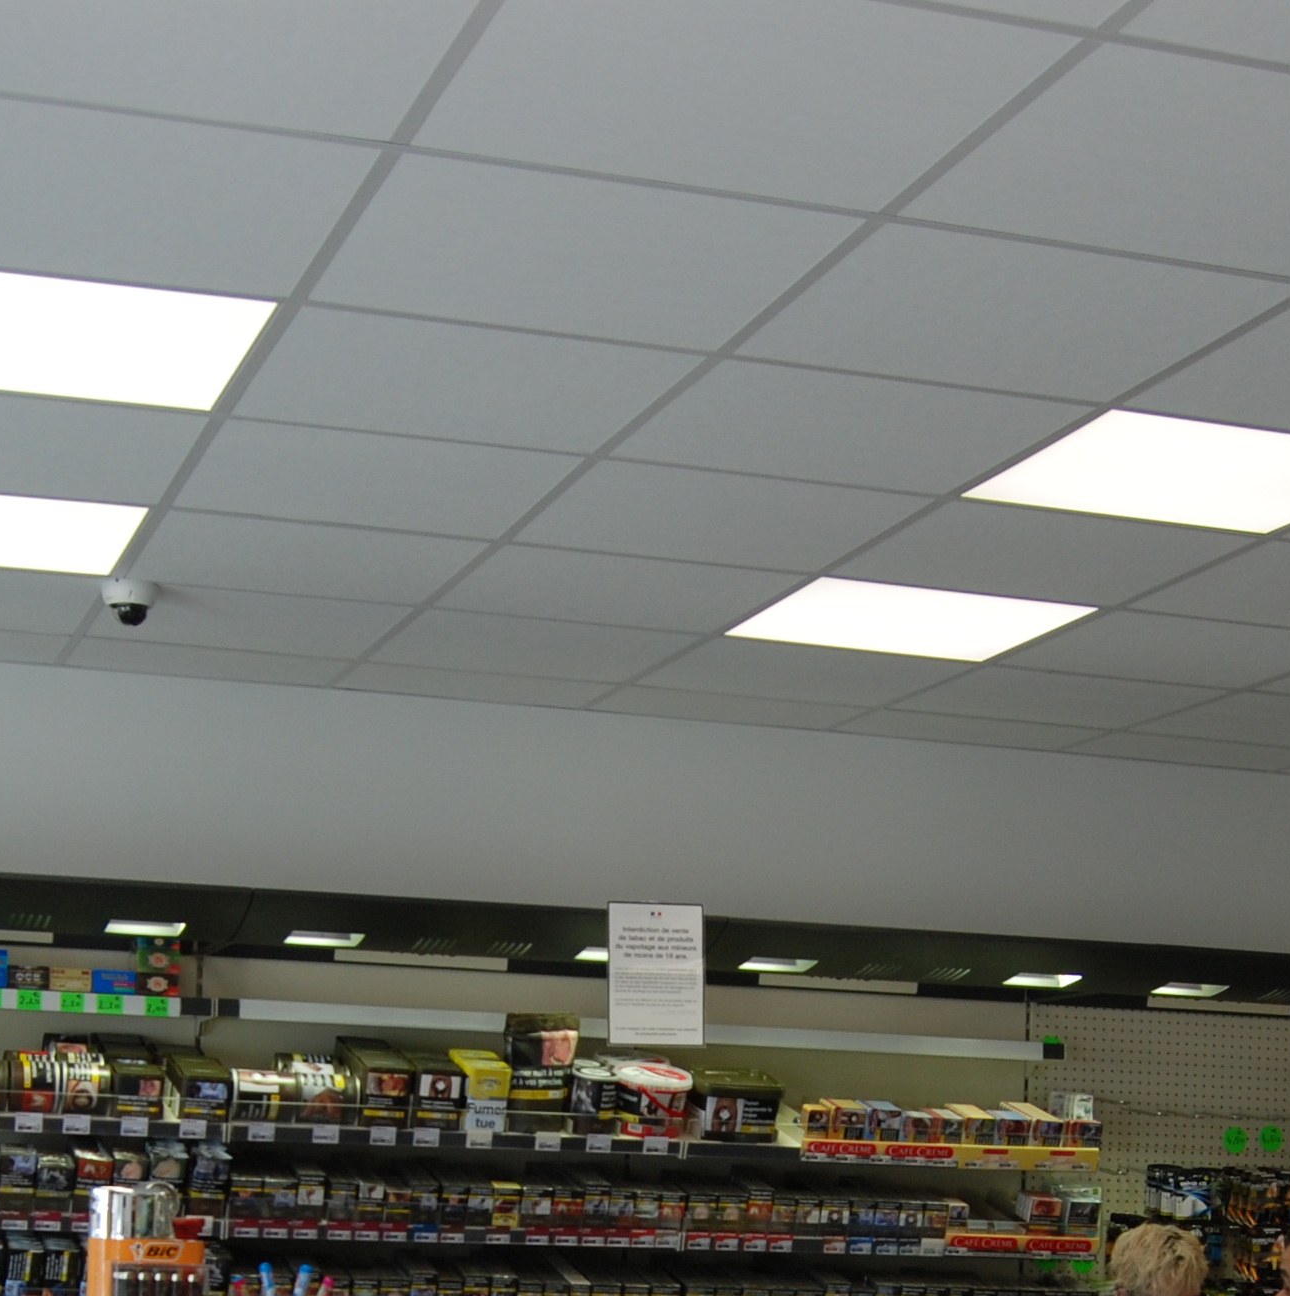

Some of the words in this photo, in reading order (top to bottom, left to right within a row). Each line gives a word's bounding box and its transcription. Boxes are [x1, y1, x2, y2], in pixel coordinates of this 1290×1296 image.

[467, 1103, 506, 1116] Fumer
[475, 1117, 496, 1130] tue
[811, 1142, 837, 1154] CAFÉ
[887, 1145, 915, 1156] CAFÉ
